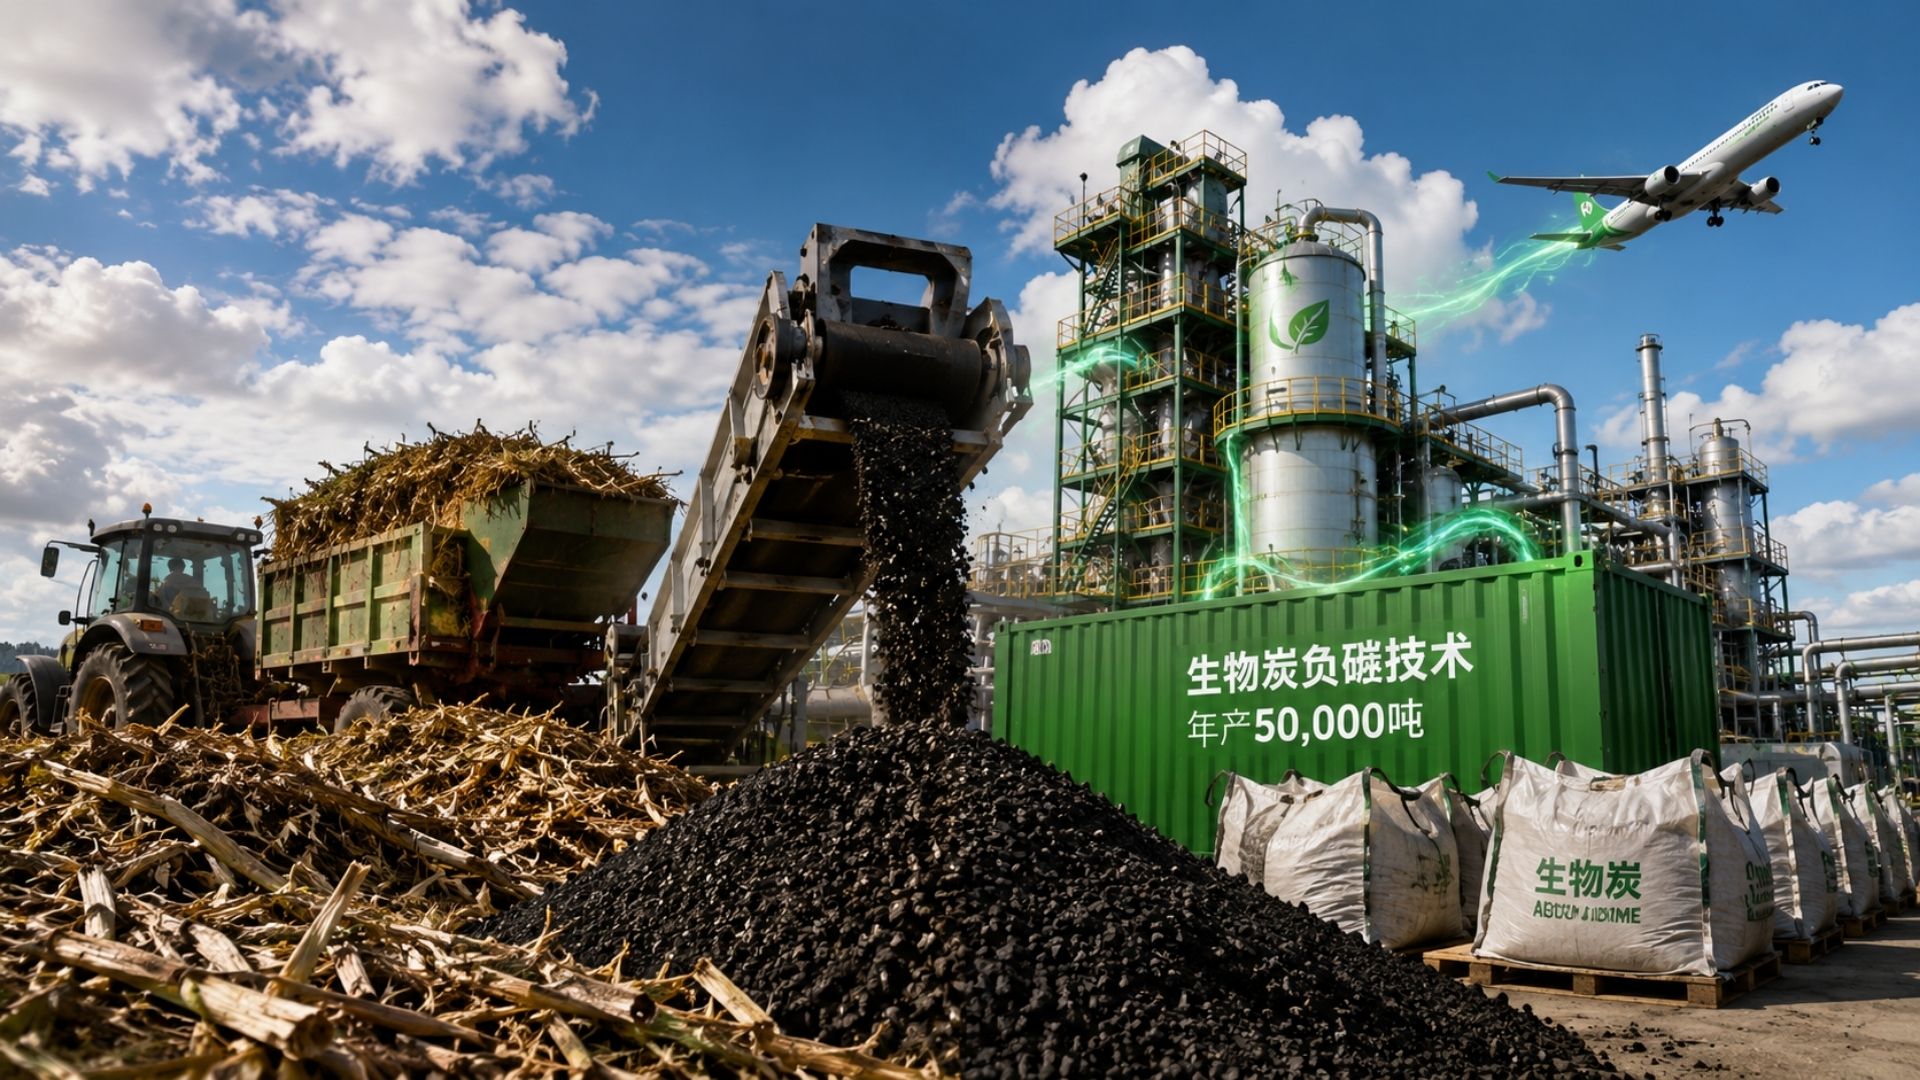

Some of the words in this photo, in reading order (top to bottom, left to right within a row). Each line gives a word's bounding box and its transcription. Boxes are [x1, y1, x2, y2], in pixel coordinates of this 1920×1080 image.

[1187, 697, 1424, 748] 年产50,000吨
[1535, 857, 1642, 900] 生物炭
